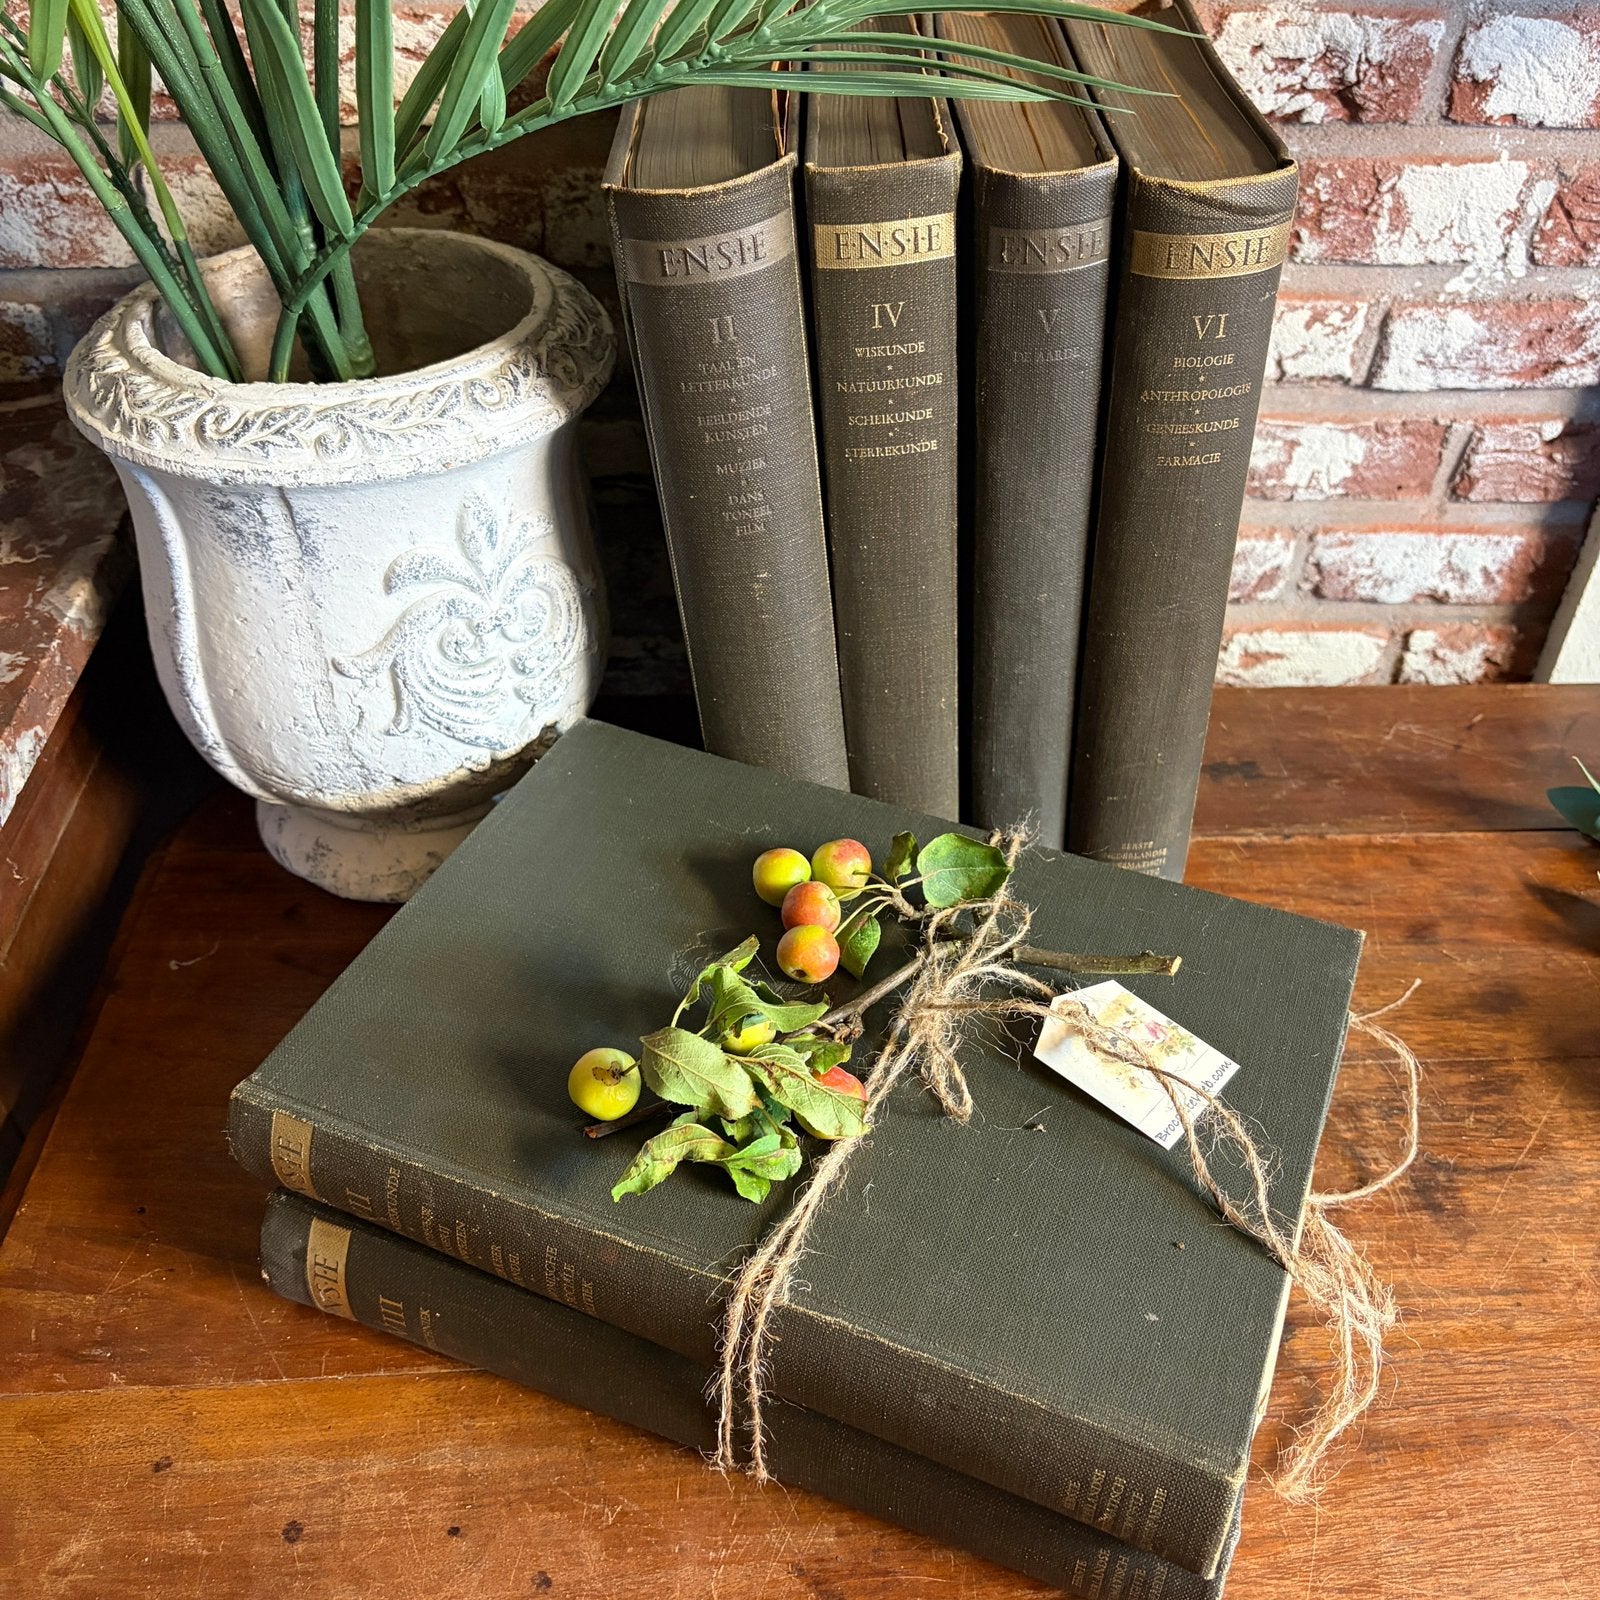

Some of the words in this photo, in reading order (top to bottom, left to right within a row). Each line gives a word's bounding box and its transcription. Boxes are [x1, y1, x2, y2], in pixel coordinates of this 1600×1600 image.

[871, 301, 905, 329] IV
[1038, 308, 1061, 334] V
[709, 315, 738, 342] II
[1192, 313, 1229, 340] VI
[854, 341, 926, 358] WISKUNDE
[1173, 353, 1235, 368] BIOLOGIE
[837, 373, 943, 393] NATUURKUNDE
[1141, 383, 1252, 402] ANTHROPOLOGIE
[848, 408, 933, 426] SCHEIKUNDE
[1146, 418, 1240, 434] GENEESKUNDE
[845, 440, 938, 458] STERREKUNDE
[1157, 453, 1222, 467] FARMACIE
